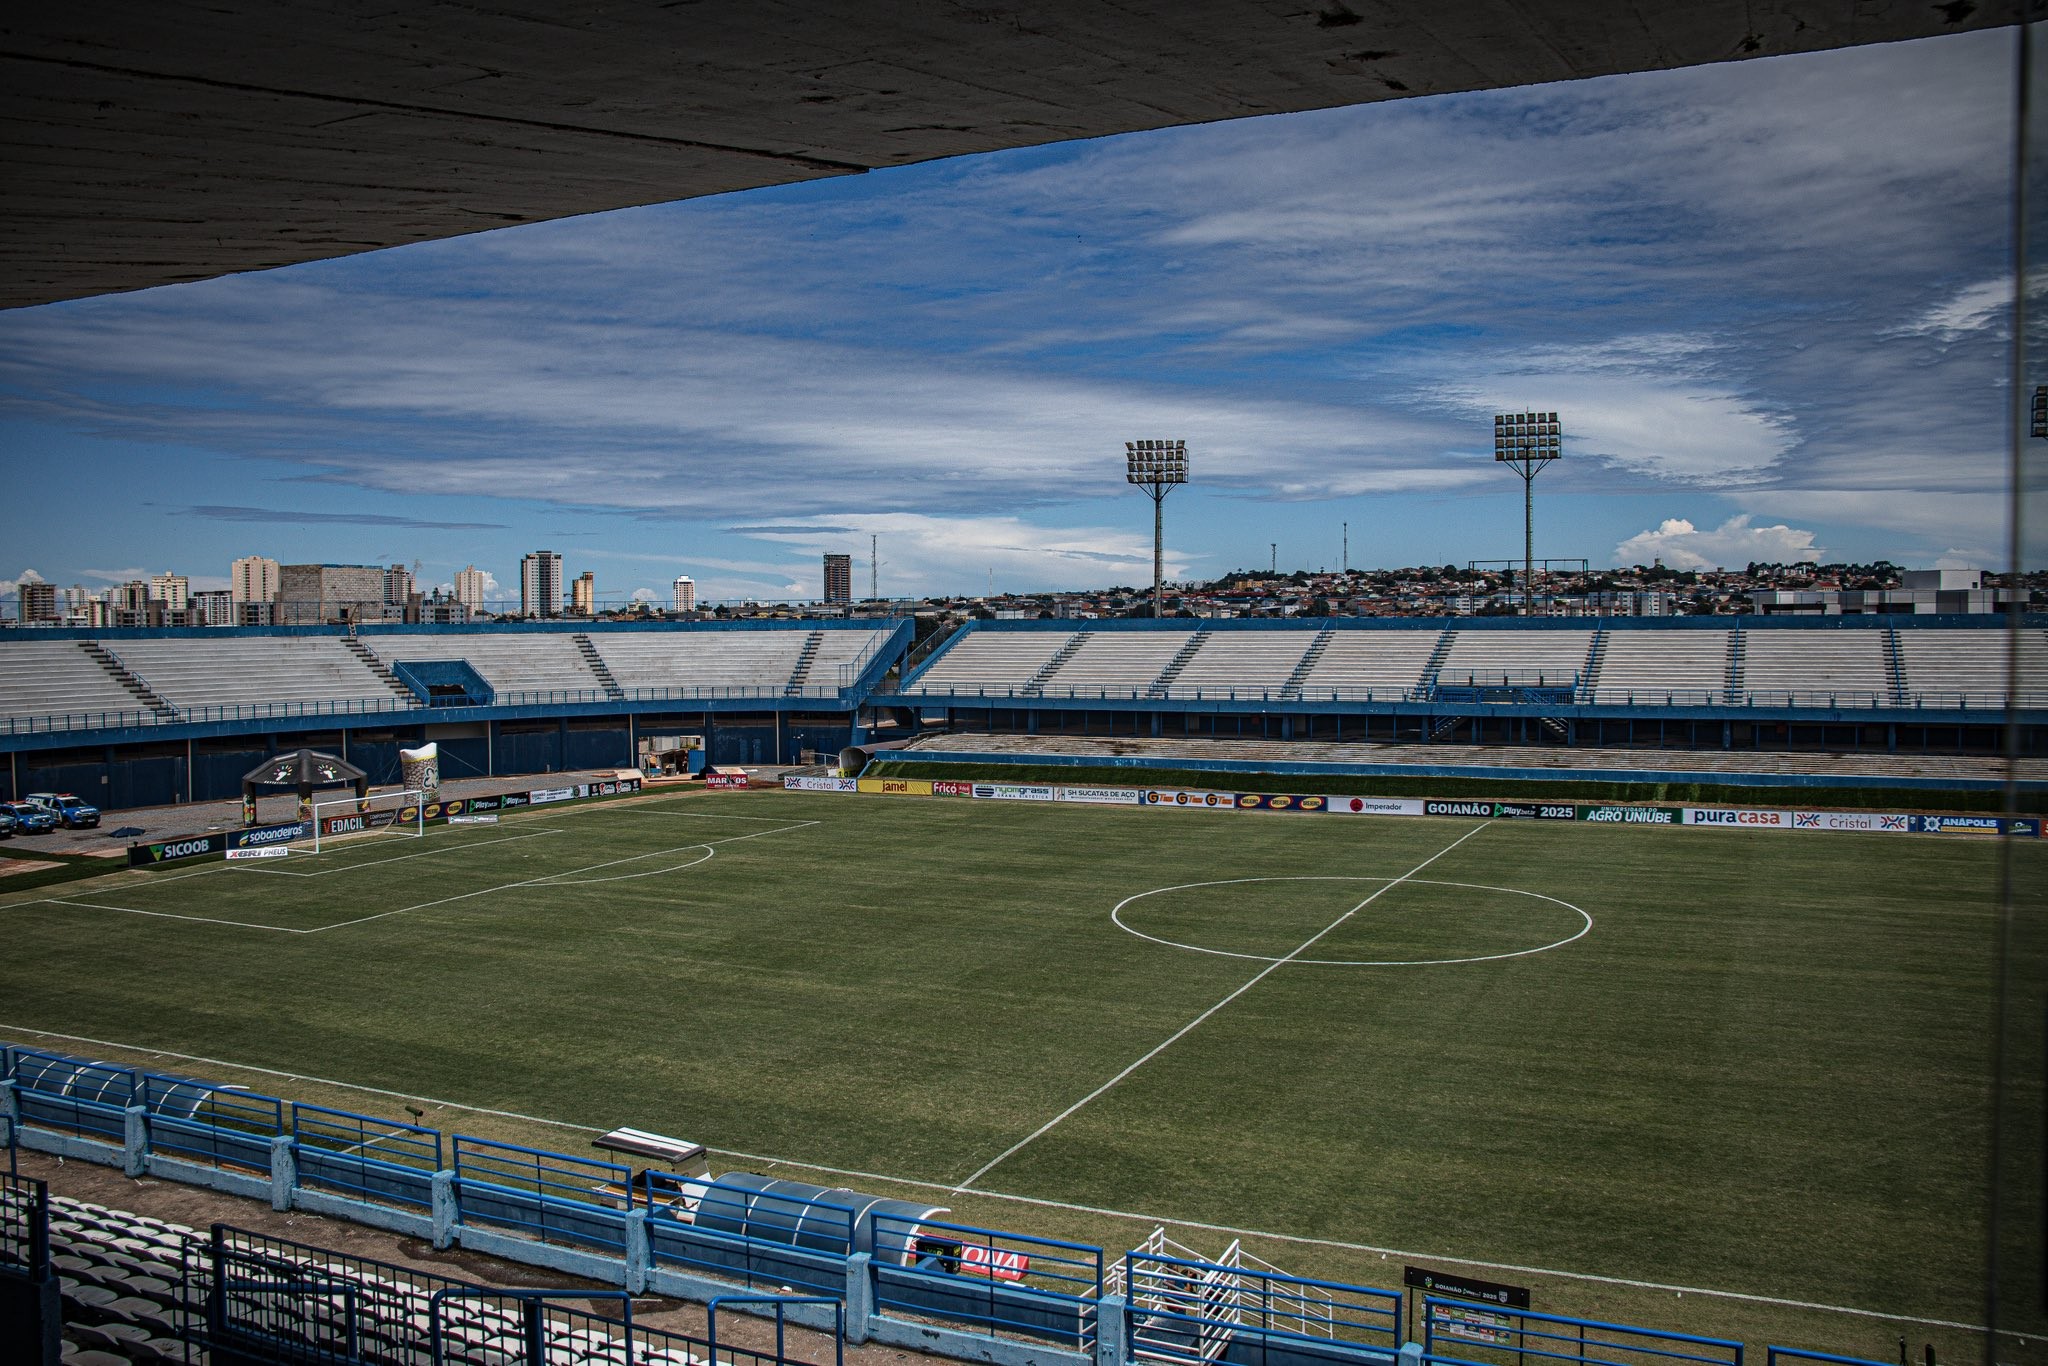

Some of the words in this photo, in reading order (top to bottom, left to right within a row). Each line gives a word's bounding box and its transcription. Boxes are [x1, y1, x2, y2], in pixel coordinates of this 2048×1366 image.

[807, 781, 833, 789] Cristal
[882, 781, 907, 792] jamel
[1365, 802, 1402, 811] Imperador
[1428, 803, 1490, 815] GOIANÃO
[1540, 807, 1573, 817] 2025
[1587, 811, 1622, 821] AGRO
[1829, 818, 1871, 828] Cristal
[164, 839, 210, 858] SICOOB
[1482, 1292, 1498, 1300] 2025
